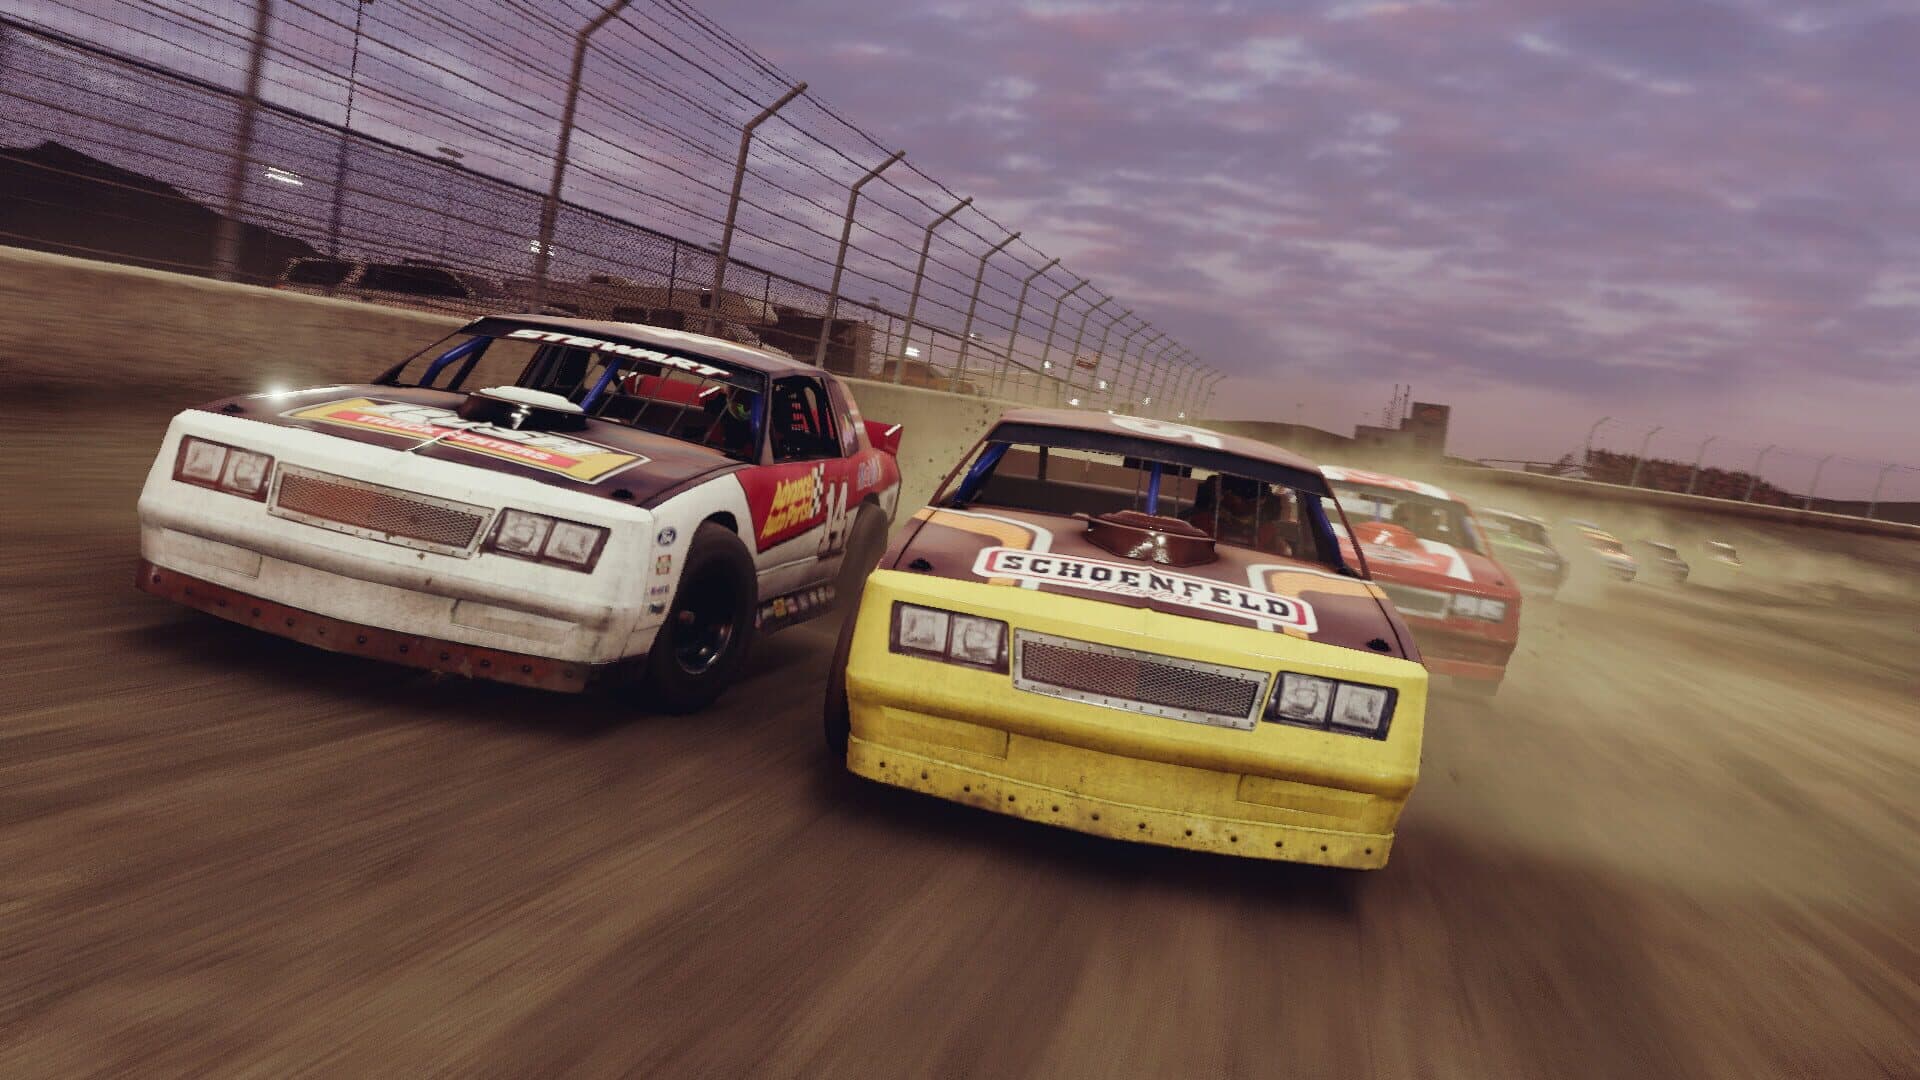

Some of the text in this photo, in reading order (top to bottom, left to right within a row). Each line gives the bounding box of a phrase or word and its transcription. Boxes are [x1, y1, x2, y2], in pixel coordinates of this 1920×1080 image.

[507, 328, 733, 377] STEWART
[819, 482, 848, 553] 14
[1001, 554, 1291, 617] SCHOENFELD
